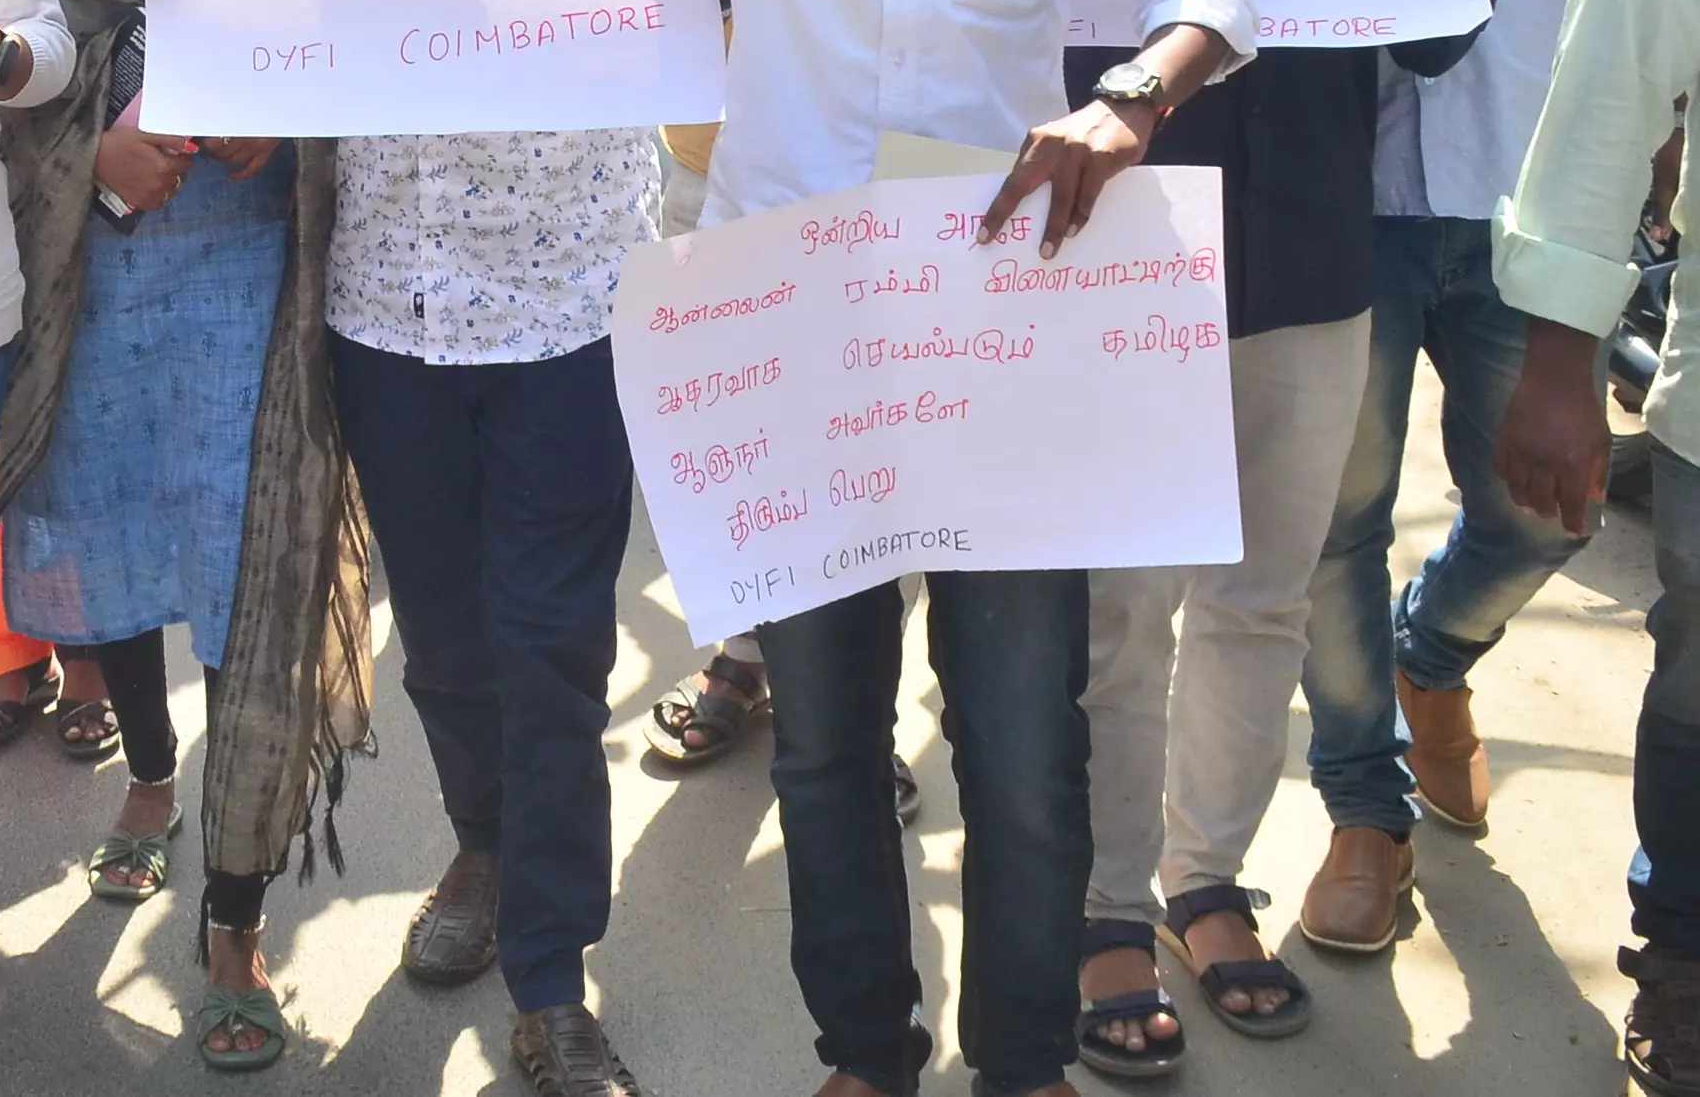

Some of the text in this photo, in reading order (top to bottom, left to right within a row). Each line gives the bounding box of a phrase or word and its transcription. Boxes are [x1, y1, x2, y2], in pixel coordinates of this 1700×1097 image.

[253, 4, 664, 71] DYFI COIMBATORE
[1261, 17, 1396, 38] BATORE
[844, 265, 939, 304] ரம்மி
[657, 357, 781, 415] ஆதரவாக
[1103, 315, 1220, 363] தமிழக
[731, 528, 972, 604] DYFI COIMBATORE
